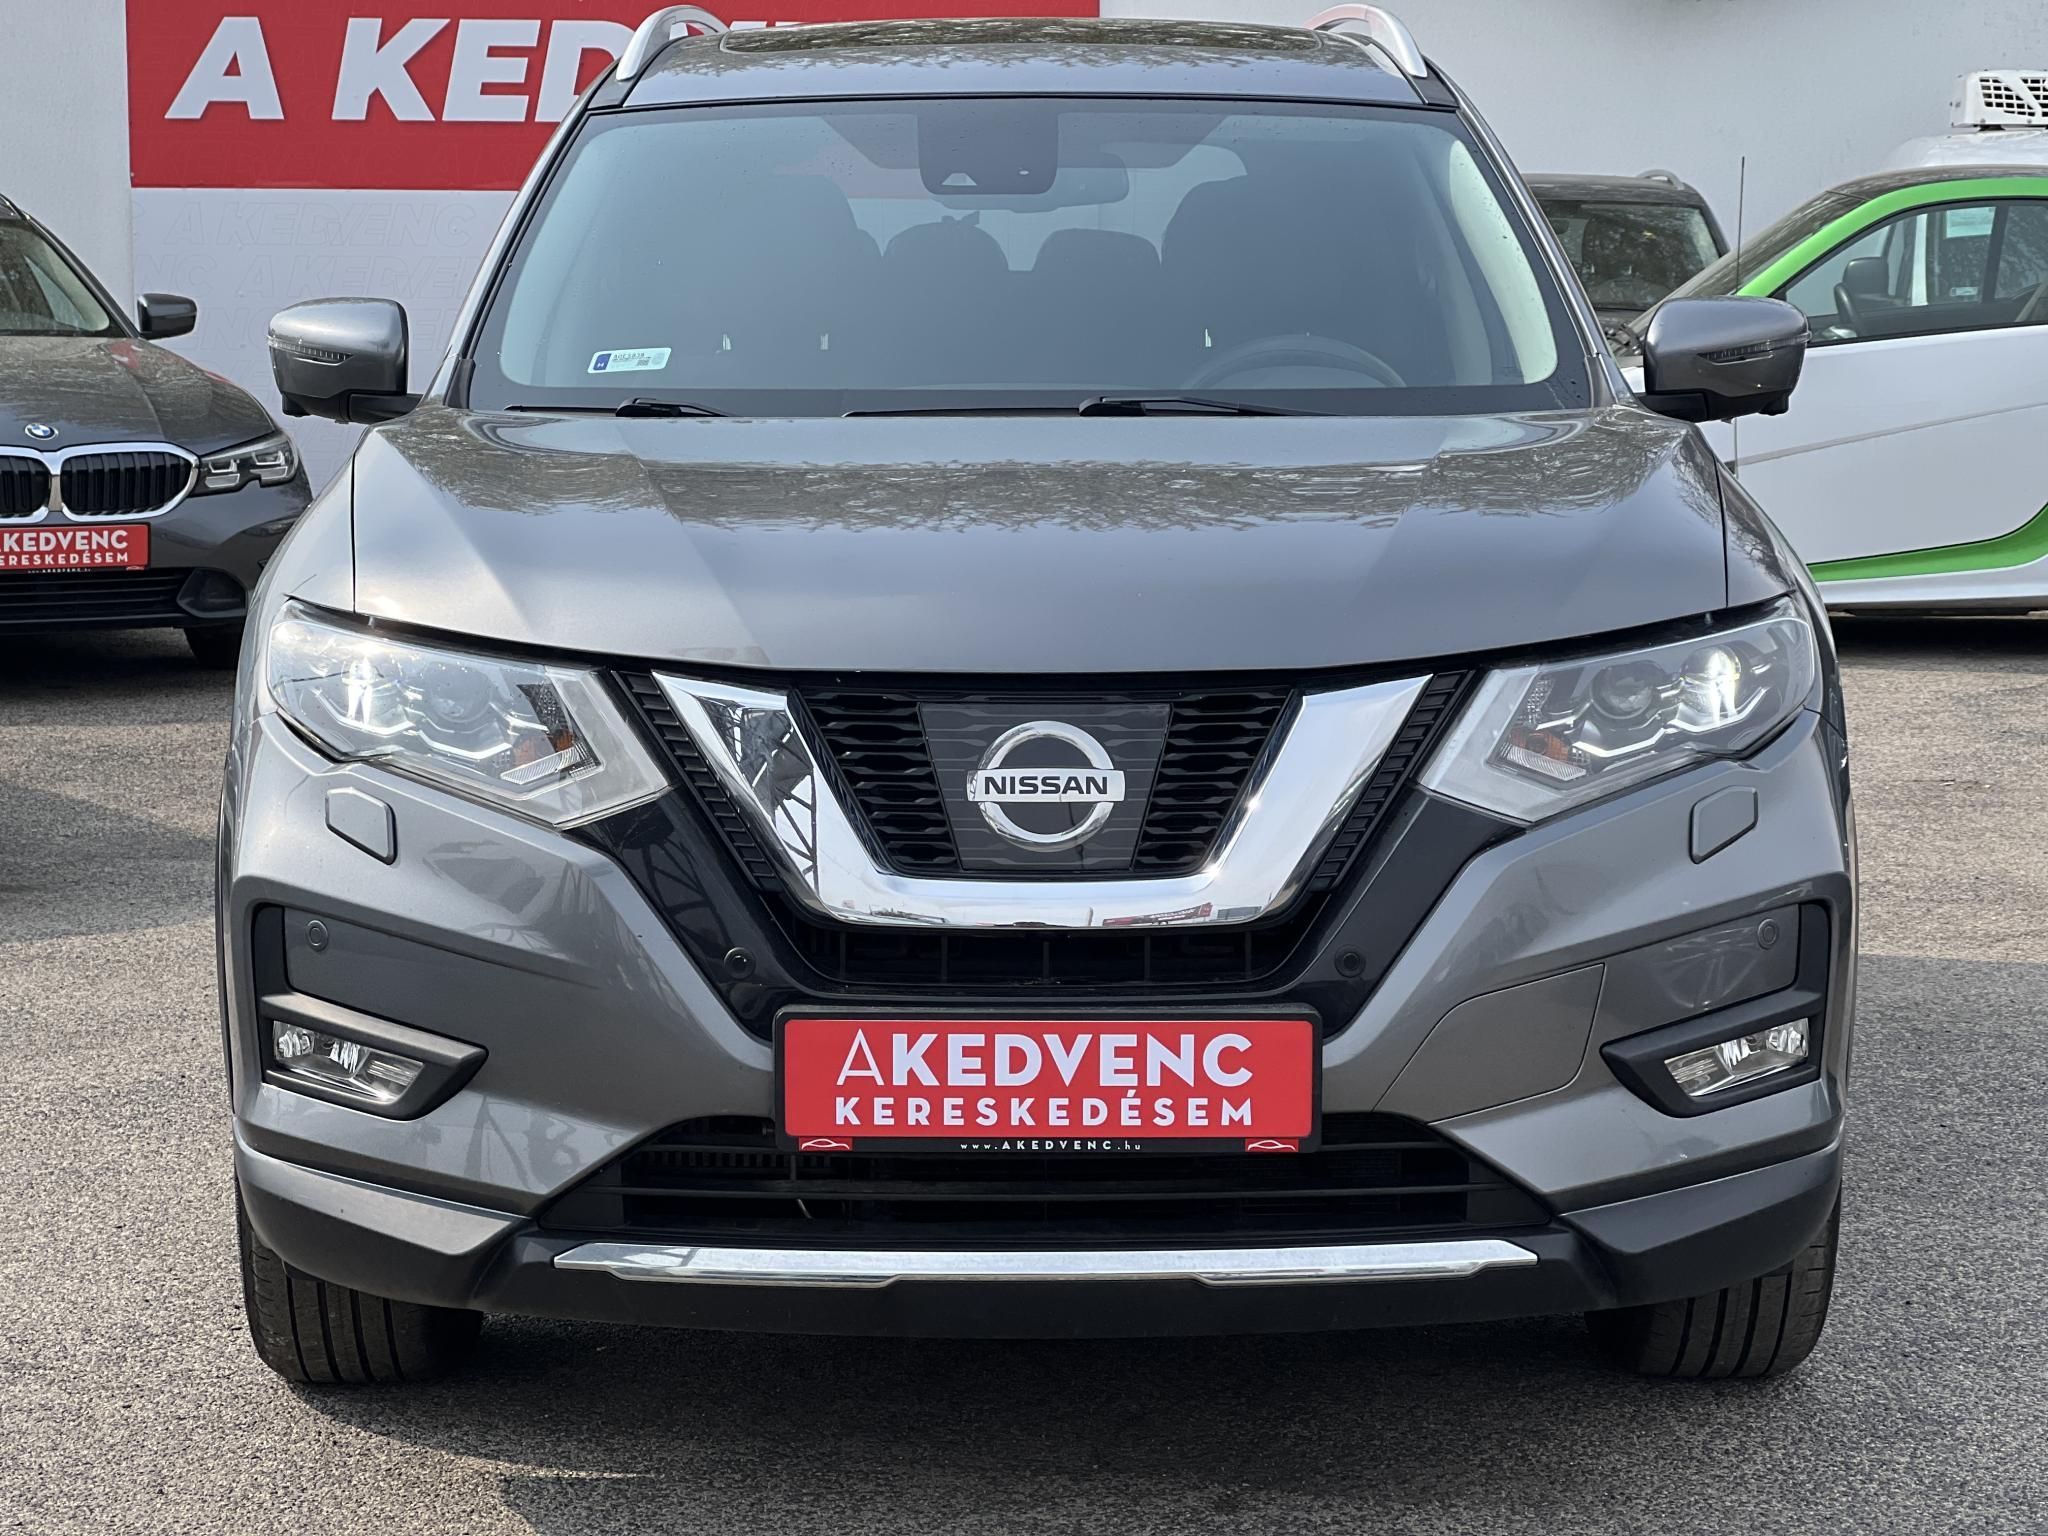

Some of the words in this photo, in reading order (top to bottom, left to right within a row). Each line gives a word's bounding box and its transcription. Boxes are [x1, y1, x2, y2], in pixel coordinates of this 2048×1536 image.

[164, 16, 284, 120] A
[0, 530, 128, 553] KEDVENC
[0, 550, 128, 566] ERESKEDÉSEM
[984, 776, 1107, 794] NISSAN
[835, 1089, 1252, 1126] KERESKEDÉSEM
[960, 1140, 1142, 1150] www.AKEDVENC.hu
